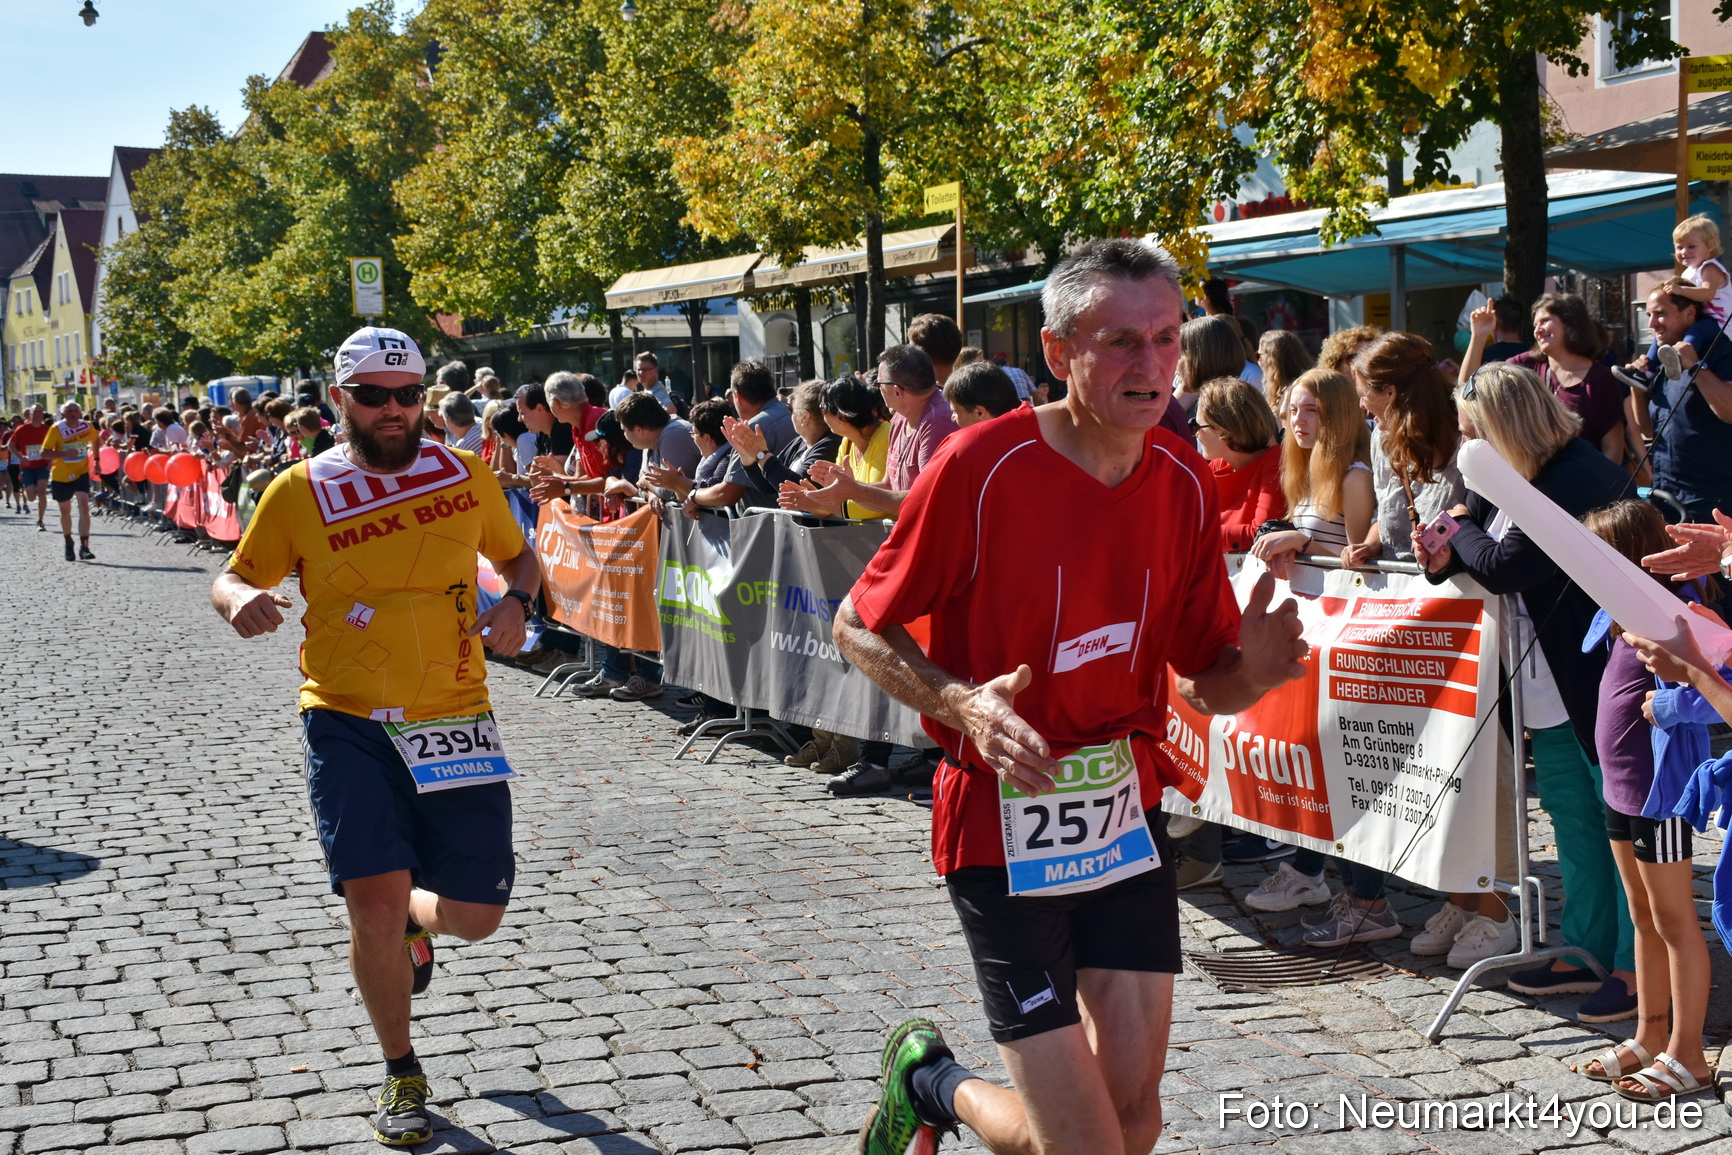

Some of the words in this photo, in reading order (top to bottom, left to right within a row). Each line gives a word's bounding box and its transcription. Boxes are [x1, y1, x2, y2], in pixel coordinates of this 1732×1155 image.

[930, 192, 957, 205] Toiletten
[327, 513, 407, 552] MAX
[412, 490, 480, 526] BÖGL
[1077, 634, 1110, 658] DEHN
[1343, 626, 1453, 647] VERZURRSYSTEME
[1336, 652, 1446, 677] RUNDSCHLINGEN
[1336, 682, 1427, 704] HEBEBÄNDER
[1339, 716, 1374, 734] Braun
[1378, 720, 1414, 737] GmbH
[408, 727, 492, 759] 2394
[1209, 713, 1316, 791] Braun
[1342, 734, 1361, 750] Am
[1363, 736, 1415, 760] Grünberg
[1418, 743, 1423, 758] 8
[430, 761, 494, 779] THOMAS
[1344, 752, 1390, 771] D-92318
[1258, 785, 1285, 805] Sicher
[1287, 792, 1299, 806] ist
[1301, 798, 1330, 814] sicher
[1347, 777, 1369, 793] Tel.
[1371, 780, 1398, 800] 09181
[1406, 788, 1431, 809] 2307-0
[1023, 784, 1131, 850] 2577
[1351, 794, 1370, 811] Fax
[1373, 798, 1397, 818] 09181
[1044, 843, 1123, 883] MARTIN
